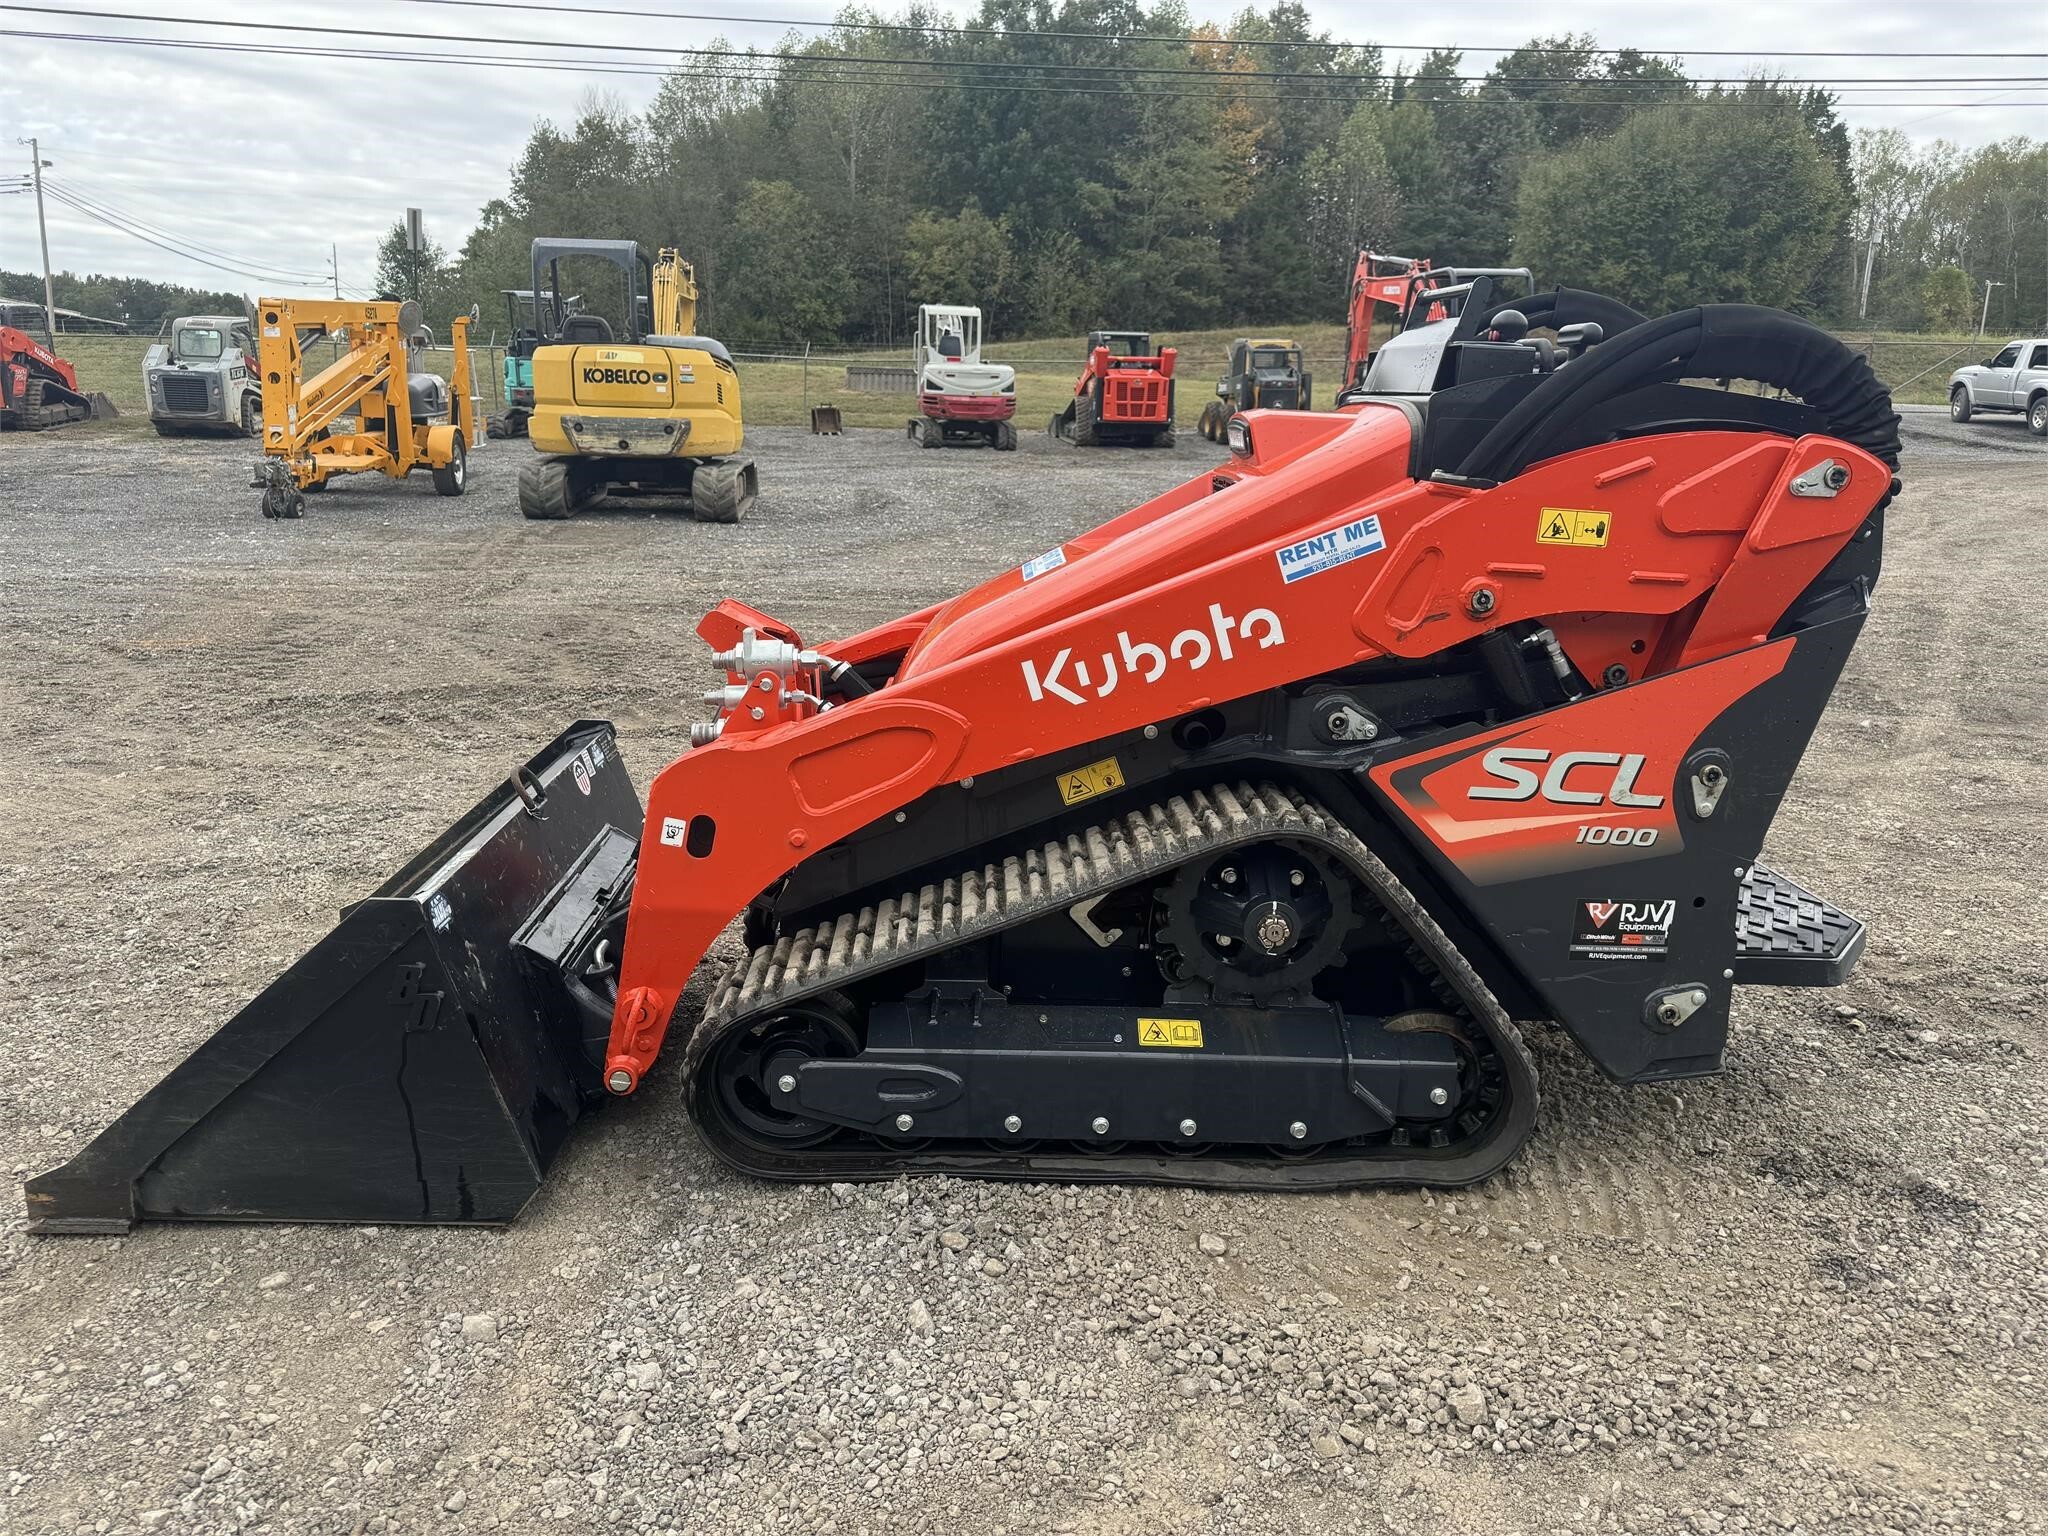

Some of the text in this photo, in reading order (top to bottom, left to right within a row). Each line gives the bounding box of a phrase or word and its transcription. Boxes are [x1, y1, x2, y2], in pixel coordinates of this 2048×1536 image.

[33, 345, 54, 365] KUBOTA
[583, 367, 651, 385] KOBELCO
[1279, 517, 1378, 566] RENT ME
[1020, 602, 1286, 706] Kubota
[1467, 747, 1666, 809] SCL
[1575, 825, 1659, 847] 1000
[1620, 903, 1668, 922] RJV
[1618, 922, 1664, 932] Equipment
[1588, 952, 1648, 960] RJVEquipment.com
